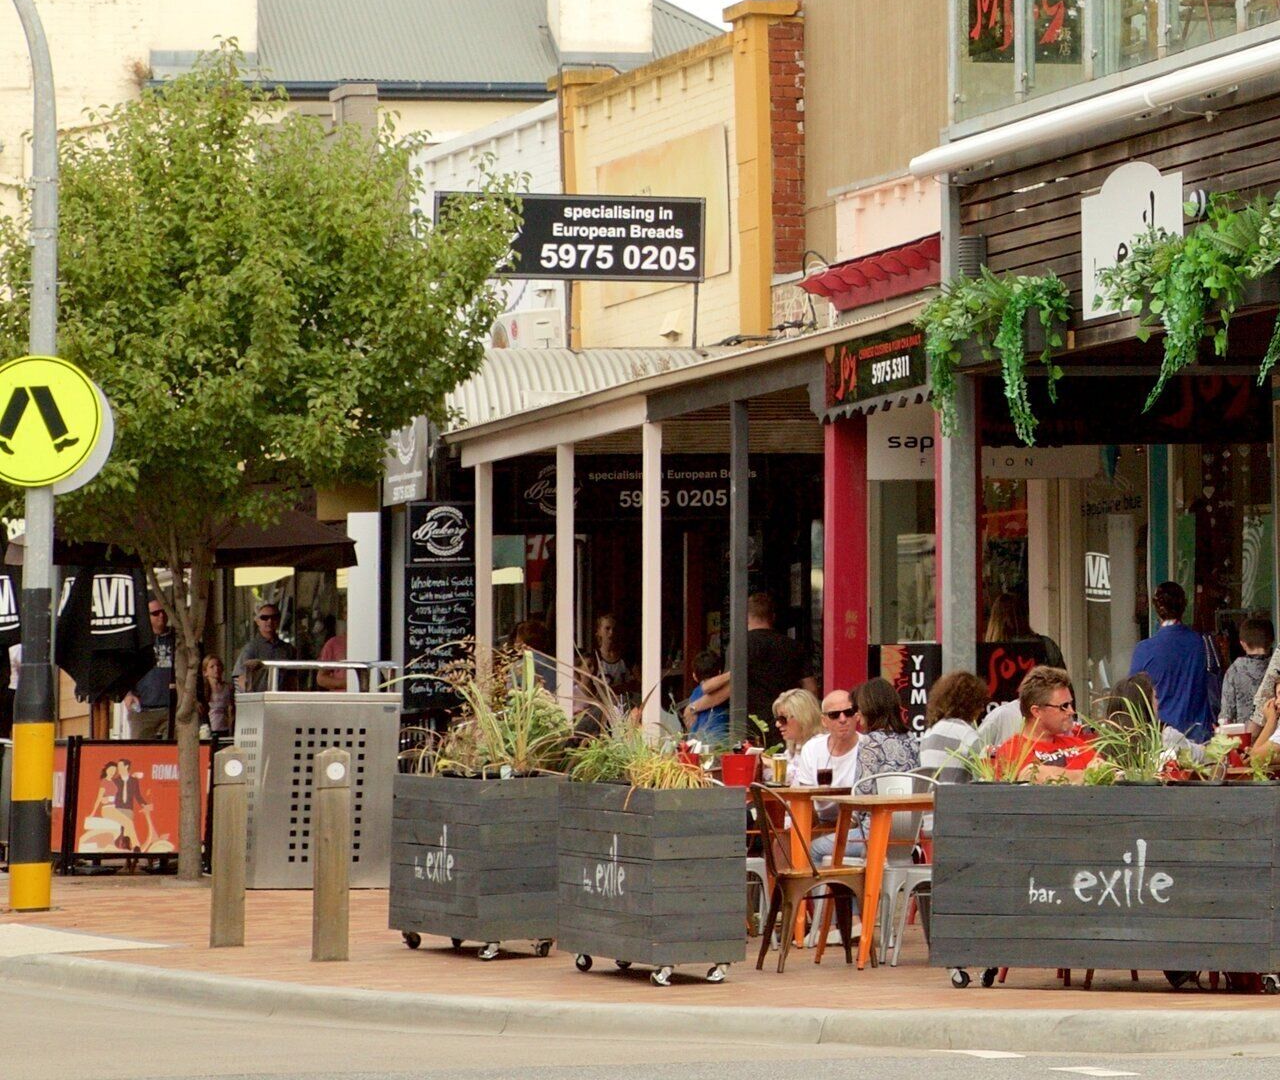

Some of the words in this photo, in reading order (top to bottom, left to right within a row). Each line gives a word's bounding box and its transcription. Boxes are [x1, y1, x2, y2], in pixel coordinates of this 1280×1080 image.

[563, 205, 655, 223] specialising
[659, 206, 673, 220] in
[552, 222, 626, 240] European
[630, 224, 684, 239] Breads
[540, 243, 614, 270] 5975
[622, 245, 696, 271] 0205
[871, 359, 891, 386] 5975
[891, 355, 910, 381] 5311
[667, 469, 718, 481] European
[619, 490, 670, 508] 595
[676, 489, 728, 507] 0205
[412, 520, 468, 546] Bakery
[426, 824, 454, 884] exile
[595, 833, 625, 898] exile
[1072, 838, 1174, 908] exile
